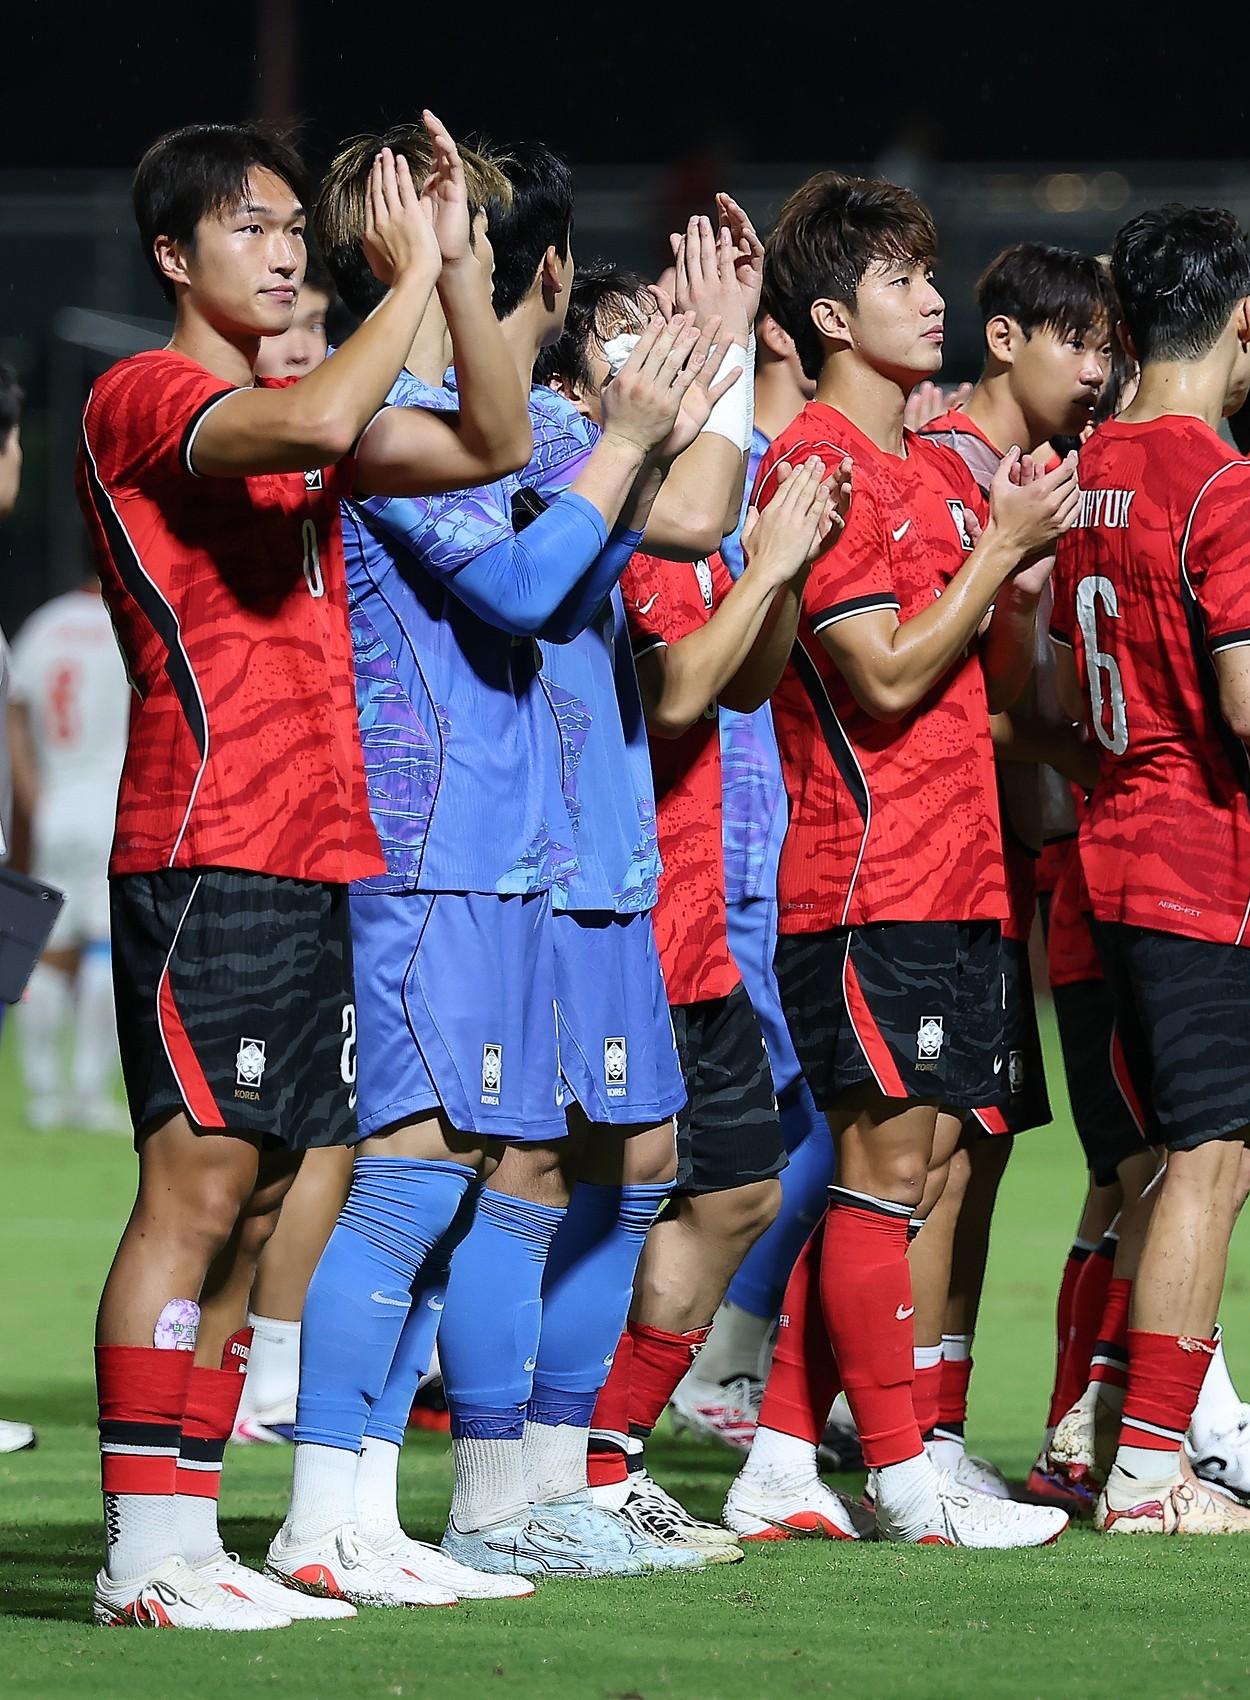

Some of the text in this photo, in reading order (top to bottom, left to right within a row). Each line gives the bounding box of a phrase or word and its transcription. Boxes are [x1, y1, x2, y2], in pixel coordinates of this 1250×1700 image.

[1076, 575, 1128, 756] 6
[234, 1088, 261, 1101] KOREA
[606, 1087, 627, 1098] KOREA
[481, 1094, 500, 1106] KOREA
